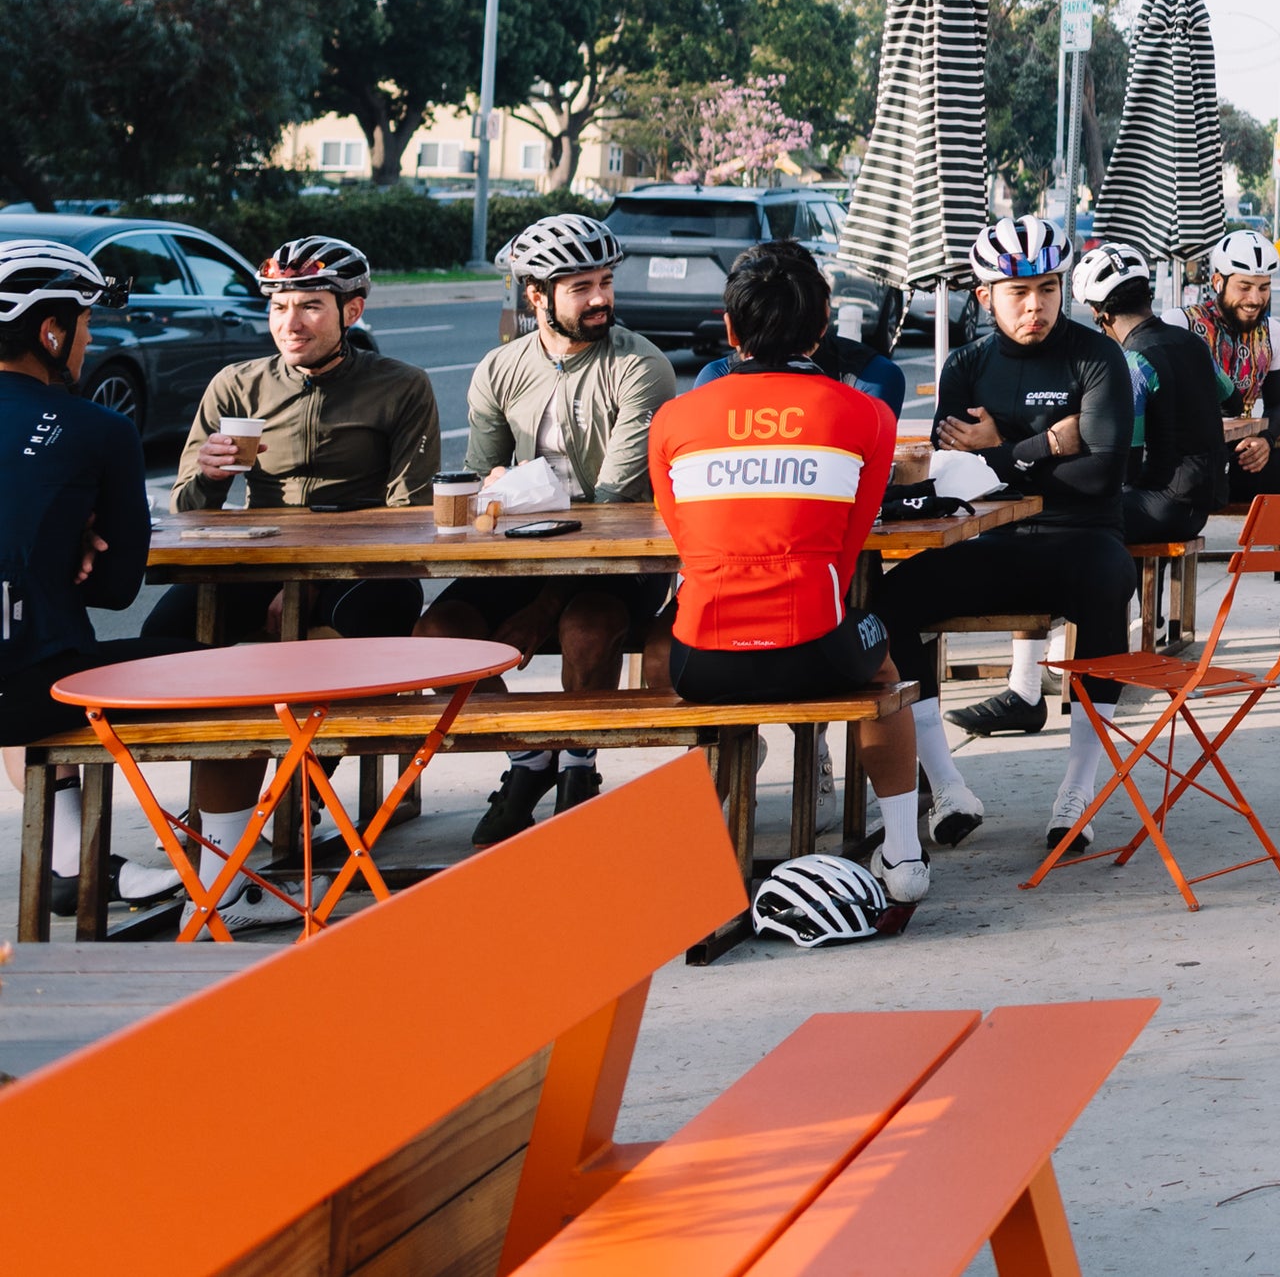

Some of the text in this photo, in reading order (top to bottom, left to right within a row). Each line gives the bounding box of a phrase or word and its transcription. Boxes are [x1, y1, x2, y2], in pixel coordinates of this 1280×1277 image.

[1064, 0, 1091, 15] PARKING
[1026, 391, 1069, 400] CADENCE
[728, 407, 804, 440] USC
[707, 457, 818, 487] CYCLING
